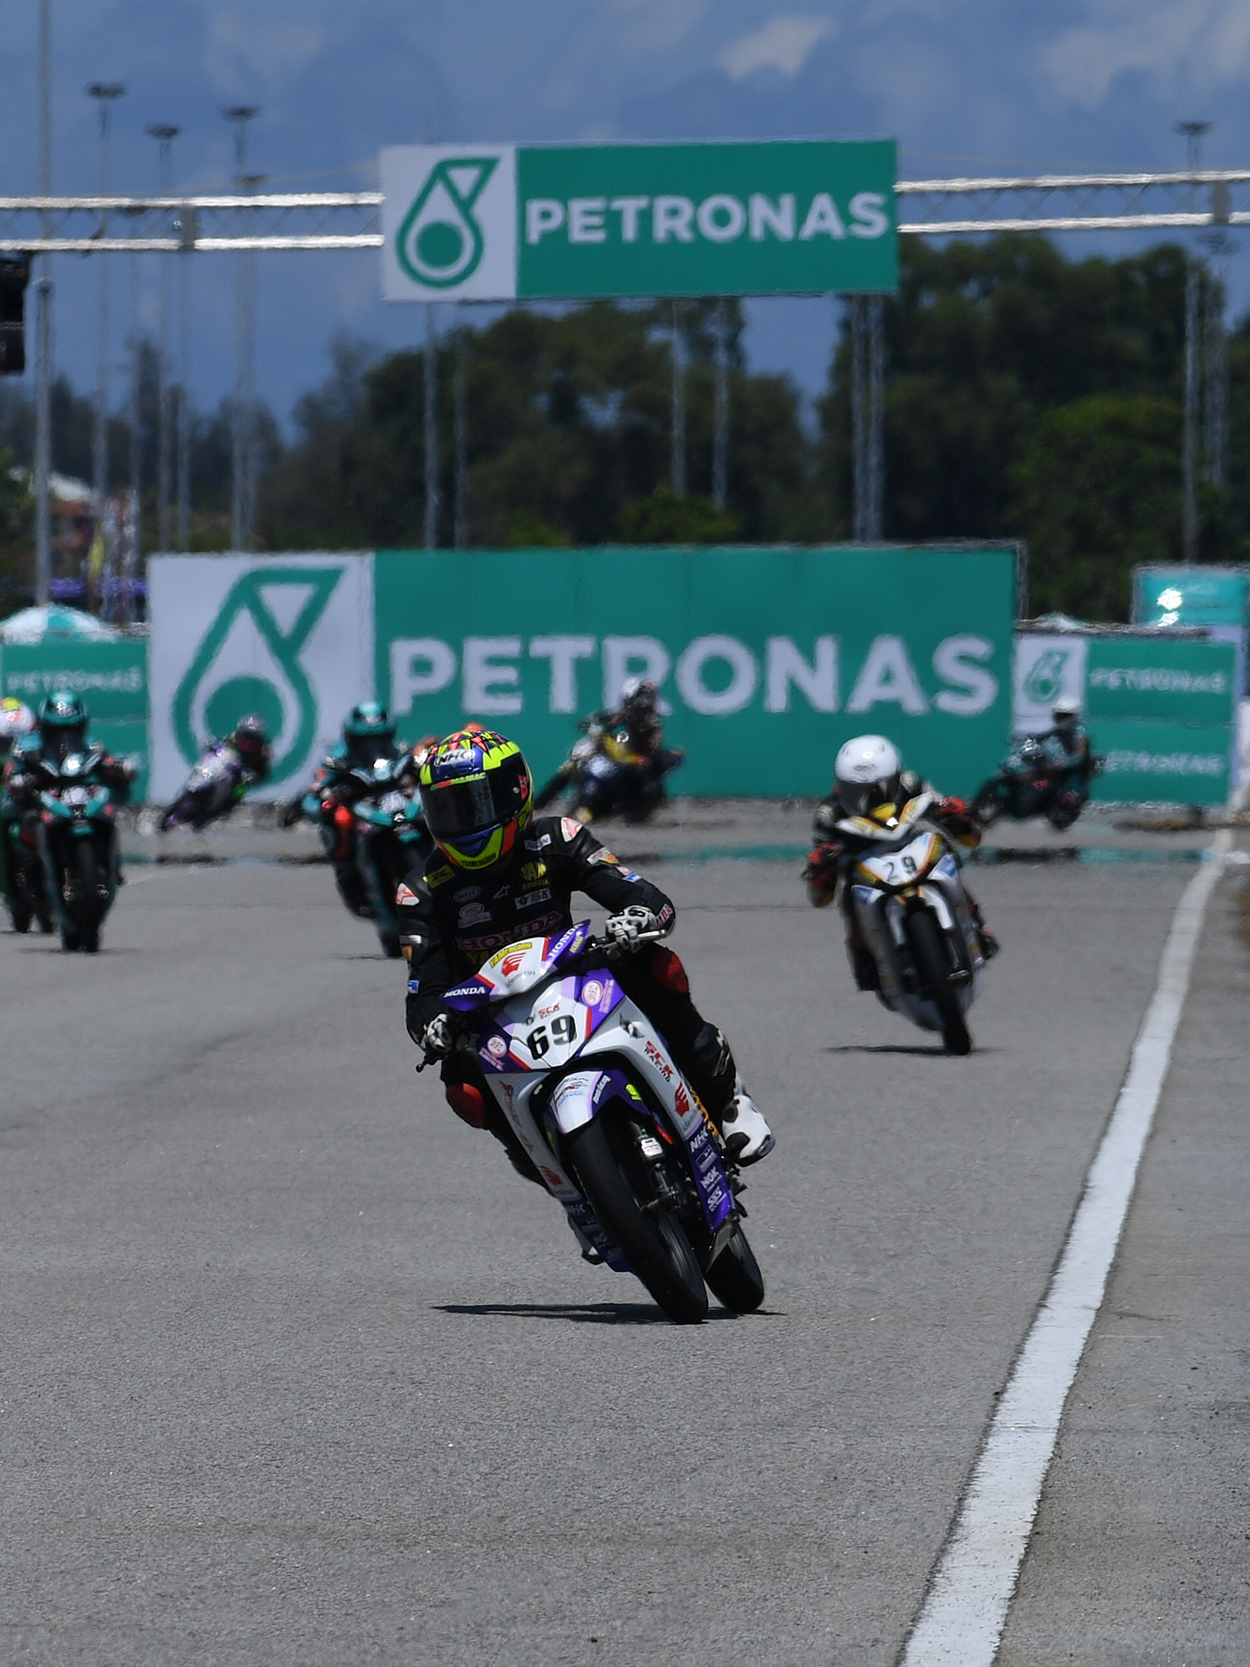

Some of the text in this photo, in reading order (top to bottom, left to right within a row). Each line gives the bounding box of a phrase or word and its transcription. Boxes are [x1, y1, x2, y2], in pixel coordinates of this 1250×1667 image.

[525, 192, 891, 245] PETRONAS
[7, 667, 144, 694] PETRONAS
[389, 634, 997, 717] PETRONAS
[1090, 668, 1228, 694] PETRONAS
[1103, 751, 1224, 776] ETRONAS
[458, 911, 562, 950] HONDA
[548, 921, 584, 959] HONDA
[443, 986, 486, 999] HONDA
[538, 1002, 561, 1016] SCK
[527, 1014, 578, 1061] 69
[645, 1040, 675, 1076] SCK
